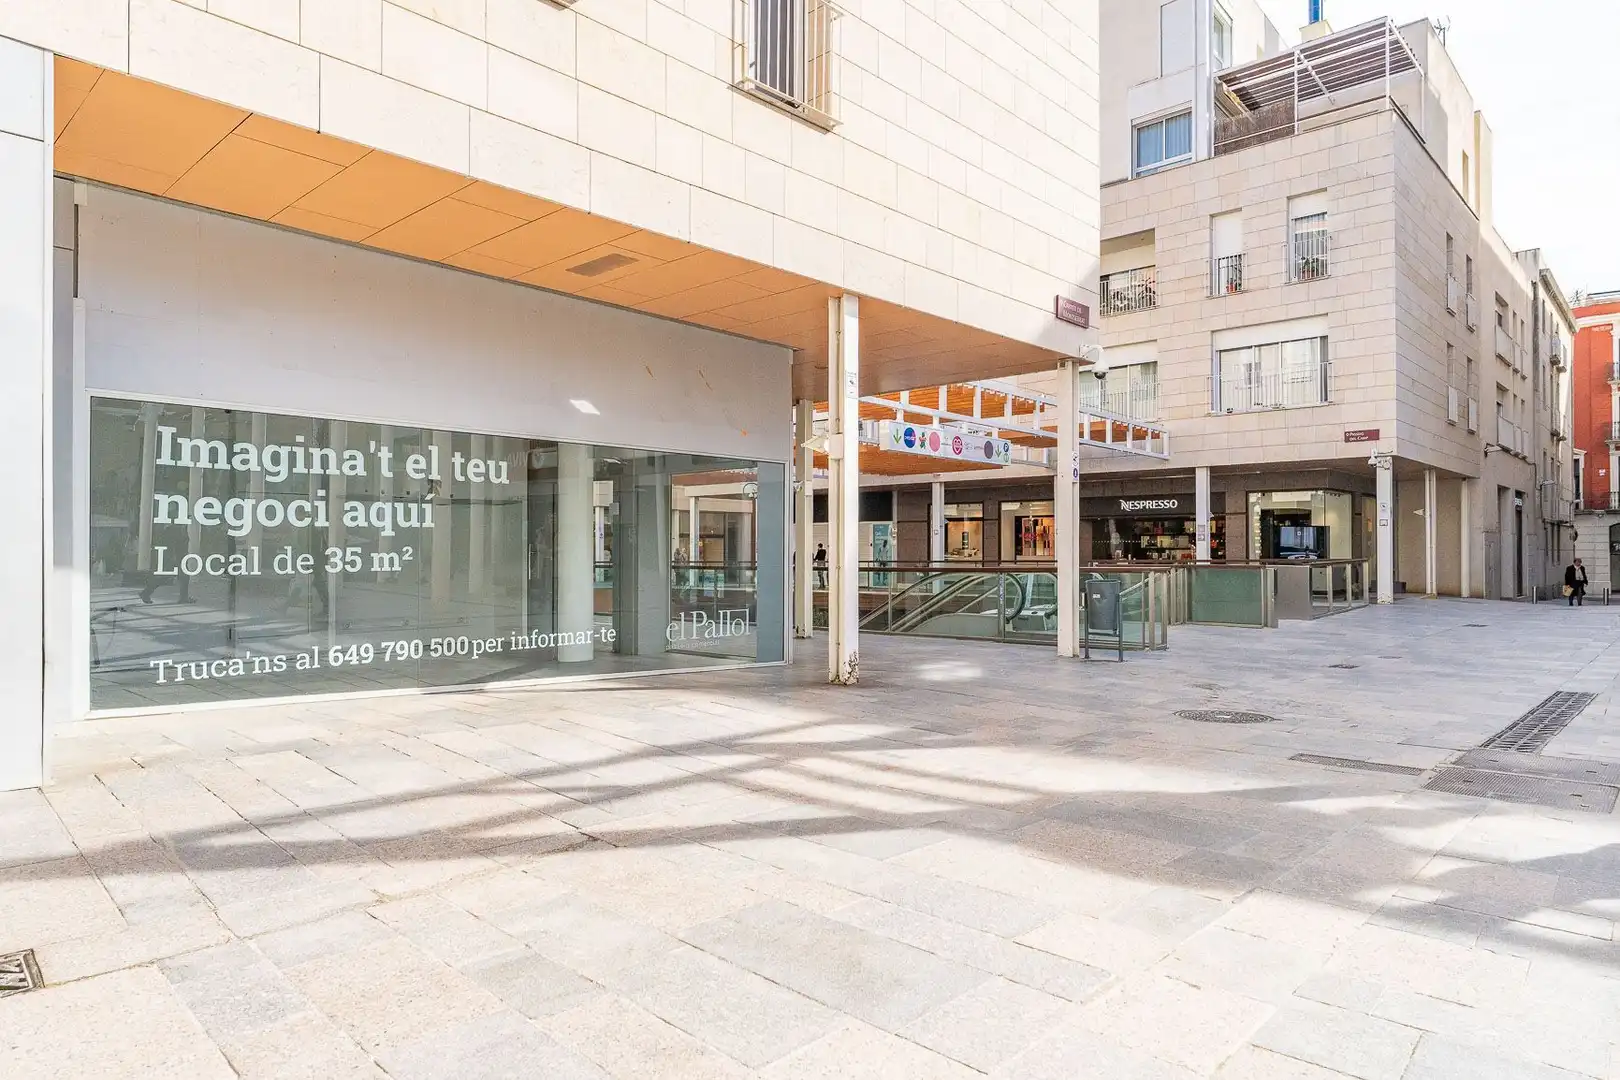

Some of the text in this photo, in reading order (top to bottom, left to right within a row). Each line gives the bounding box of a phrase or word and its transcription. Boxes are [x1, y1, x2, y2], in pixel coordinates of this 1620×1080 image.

[156, 425, 510, 484] Imagina't el teu
[153, 489, 435, 537] negoci aquí
[1120, 499, 1178, 512] NESPRESSO
[153, 546, 262, 576] Local
[273, 546, 314, 575] de
[324, 547, 363, 574] 35
[666, 608, 751, 642] el Pallol
[150, 626, 617, 684] Truca'ns al 649 790 500 per informar-te
